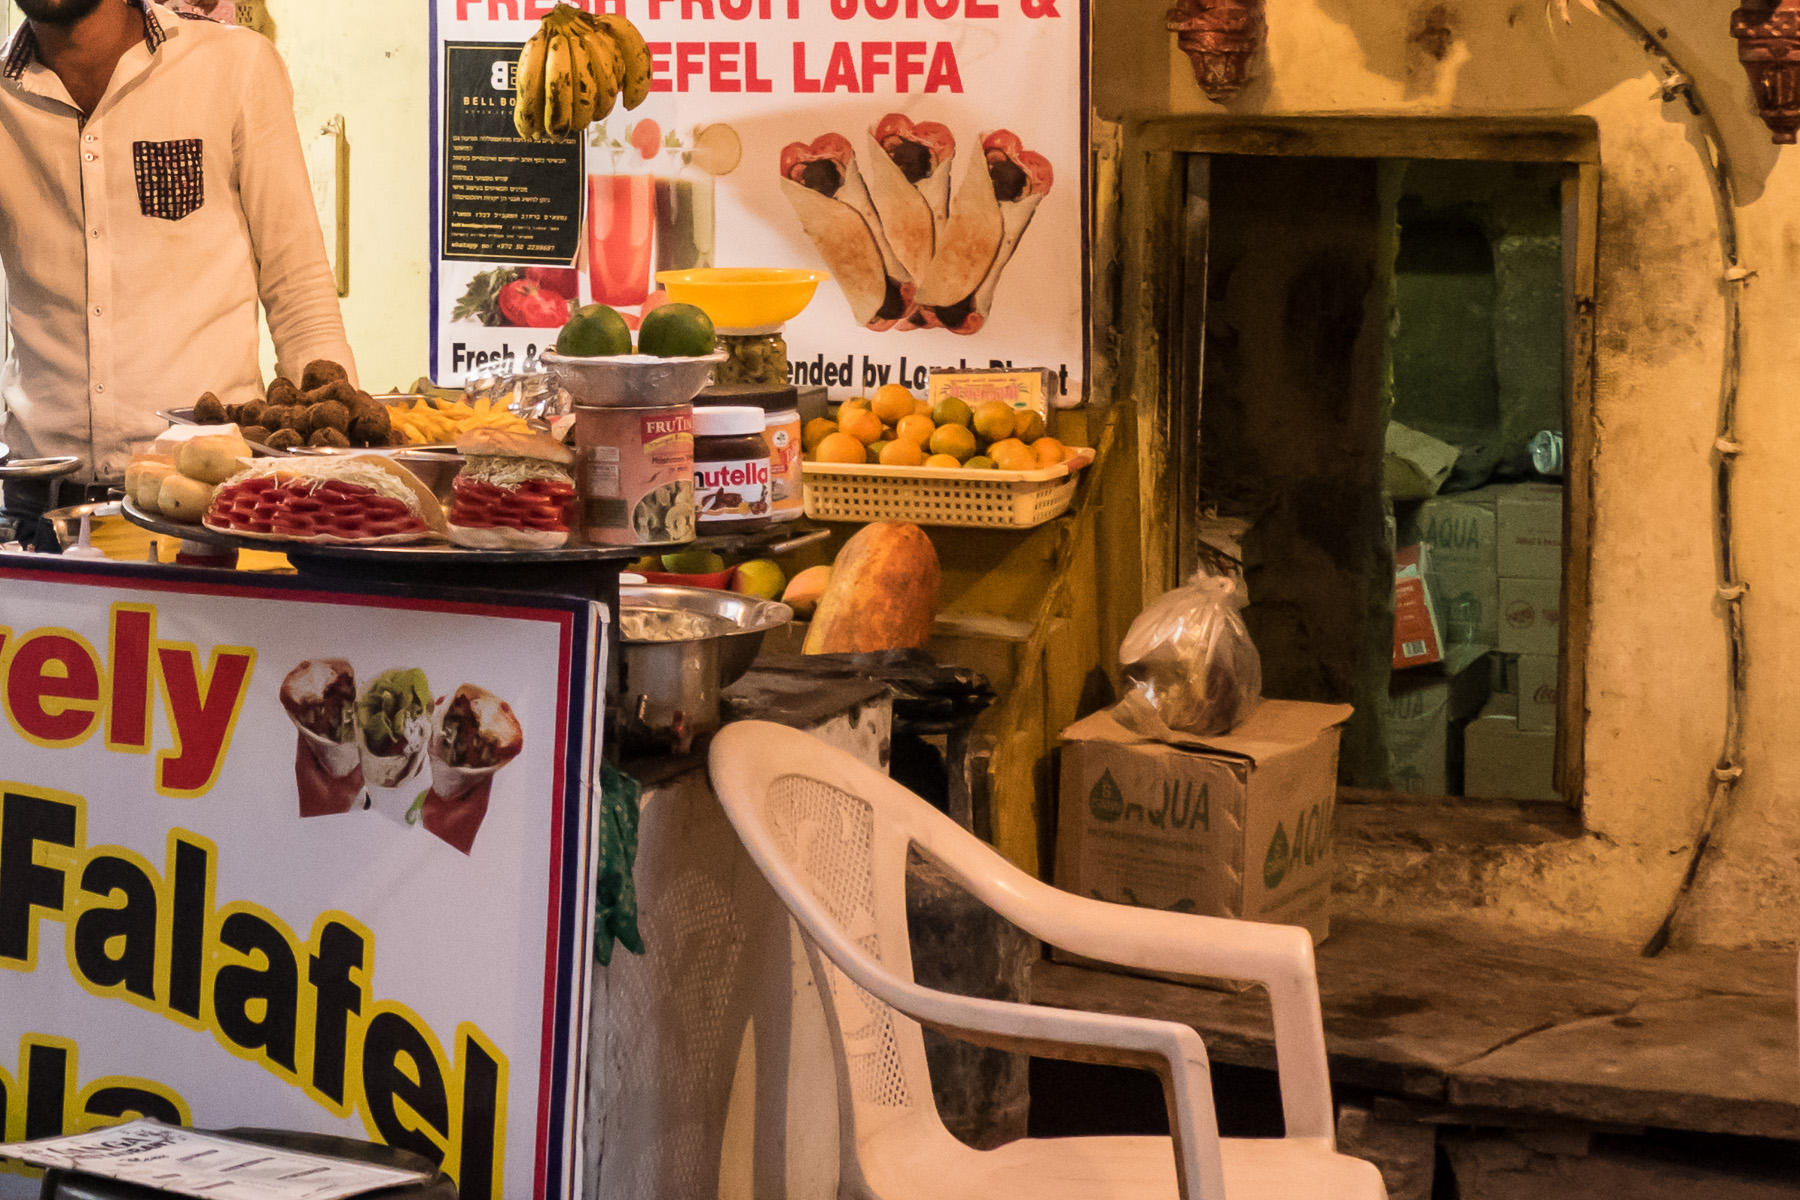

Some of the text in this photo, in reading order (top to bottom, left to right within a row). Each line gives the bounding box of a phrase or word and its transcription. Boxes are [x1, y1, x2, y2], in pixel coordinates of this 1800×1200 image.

[792, 41, 964, 95] LAFFA
[463, 96, 495, 107] BELL
[694, 462, 769, 488] nutella
